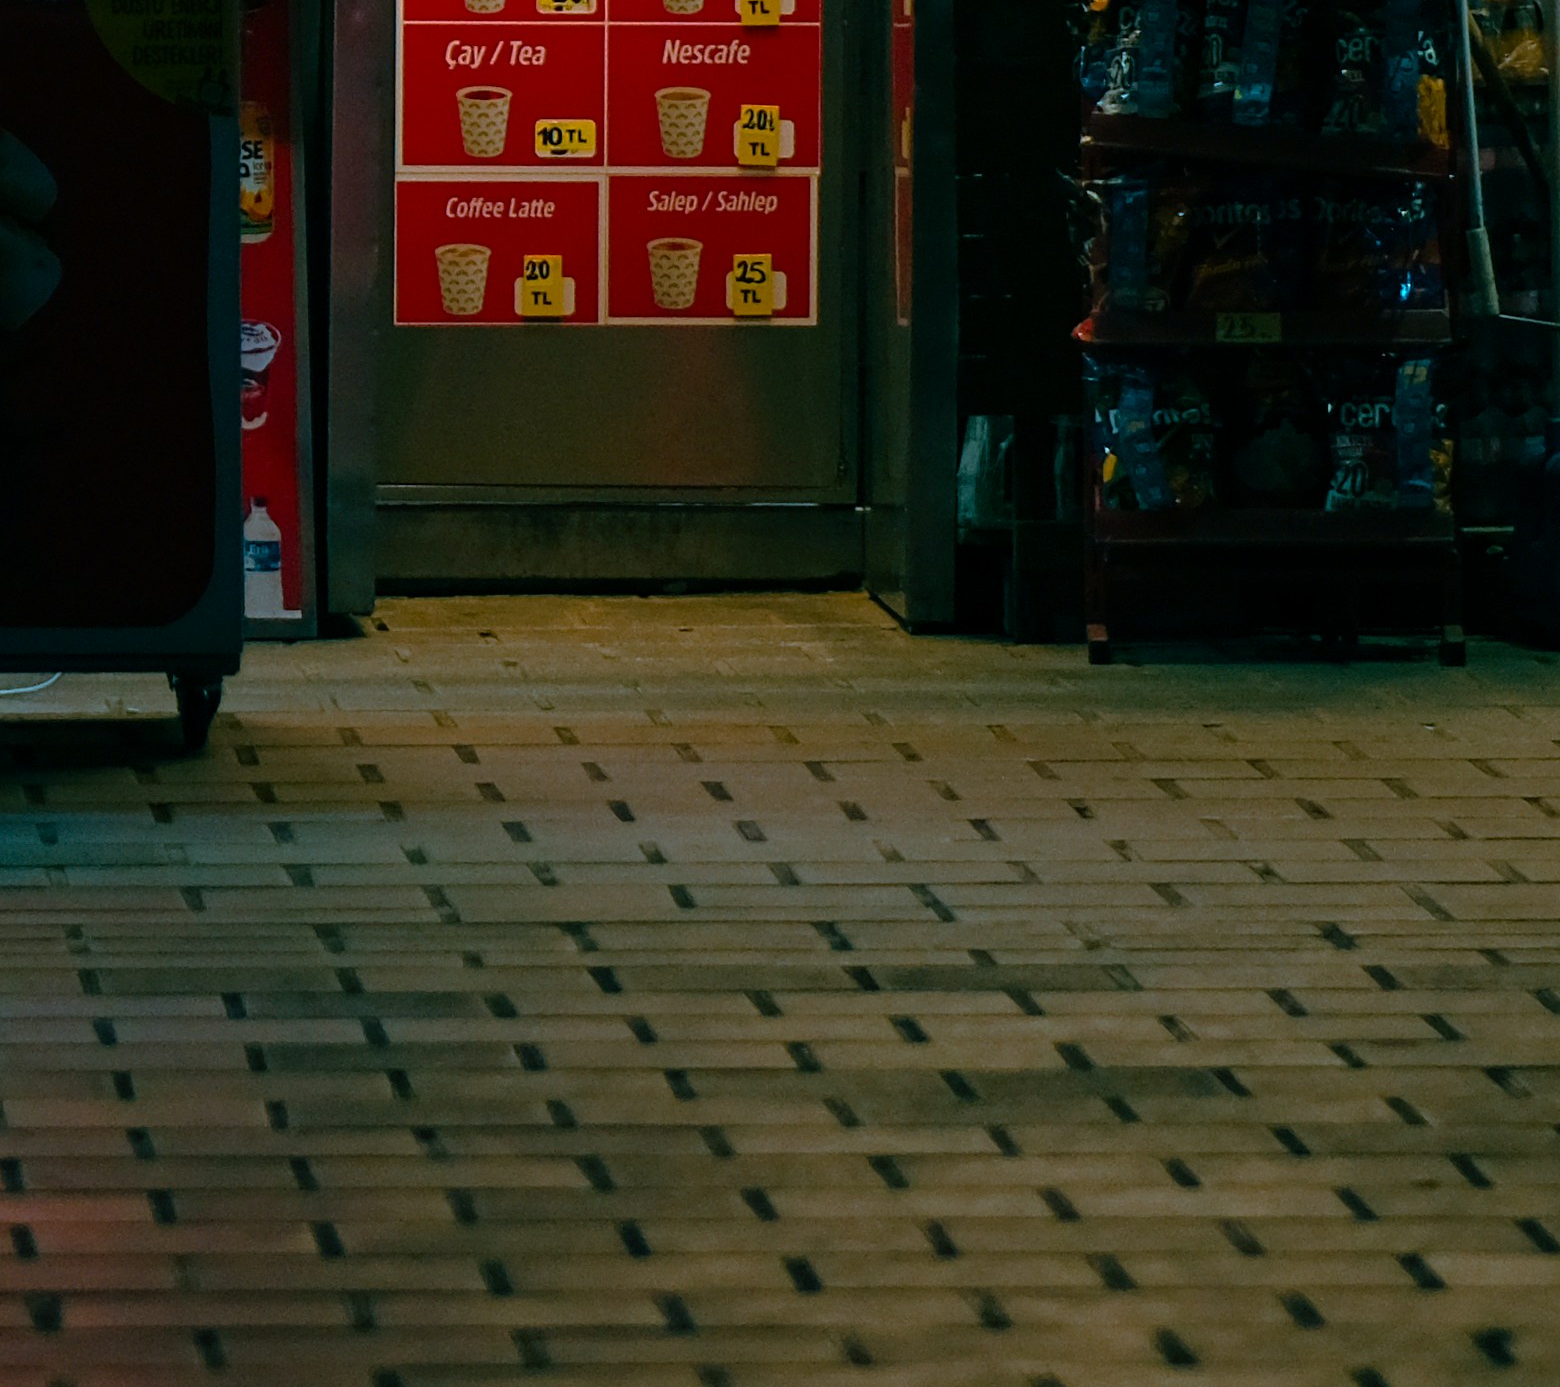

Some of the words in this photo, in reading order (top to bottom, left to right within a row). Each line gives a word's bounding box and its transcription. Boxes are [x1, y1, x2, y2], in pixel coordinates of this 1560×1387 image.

[747, 0, 770, 16] TL
[445, 40, 487, 70] Çay
[509, 41, 547, 66] Tea
[662, 39, 751, 65] Nescafe
[536, 126, 563, 146] 10
[566, 128, 588, 145] TL
[748, 142, 771, 157] TL
[445, 197, 505, 218] Coffee
[508, 197, 555, 218] Latte
[647, 190, 698, 215] Salep
[715, 191, 779, 215] Sahlep
[525, 260, 550, 281] 20
[735, 261, 767, 284] 25
[530, 290, 552, 306] TL
[740, 289, 762, 305] TL
